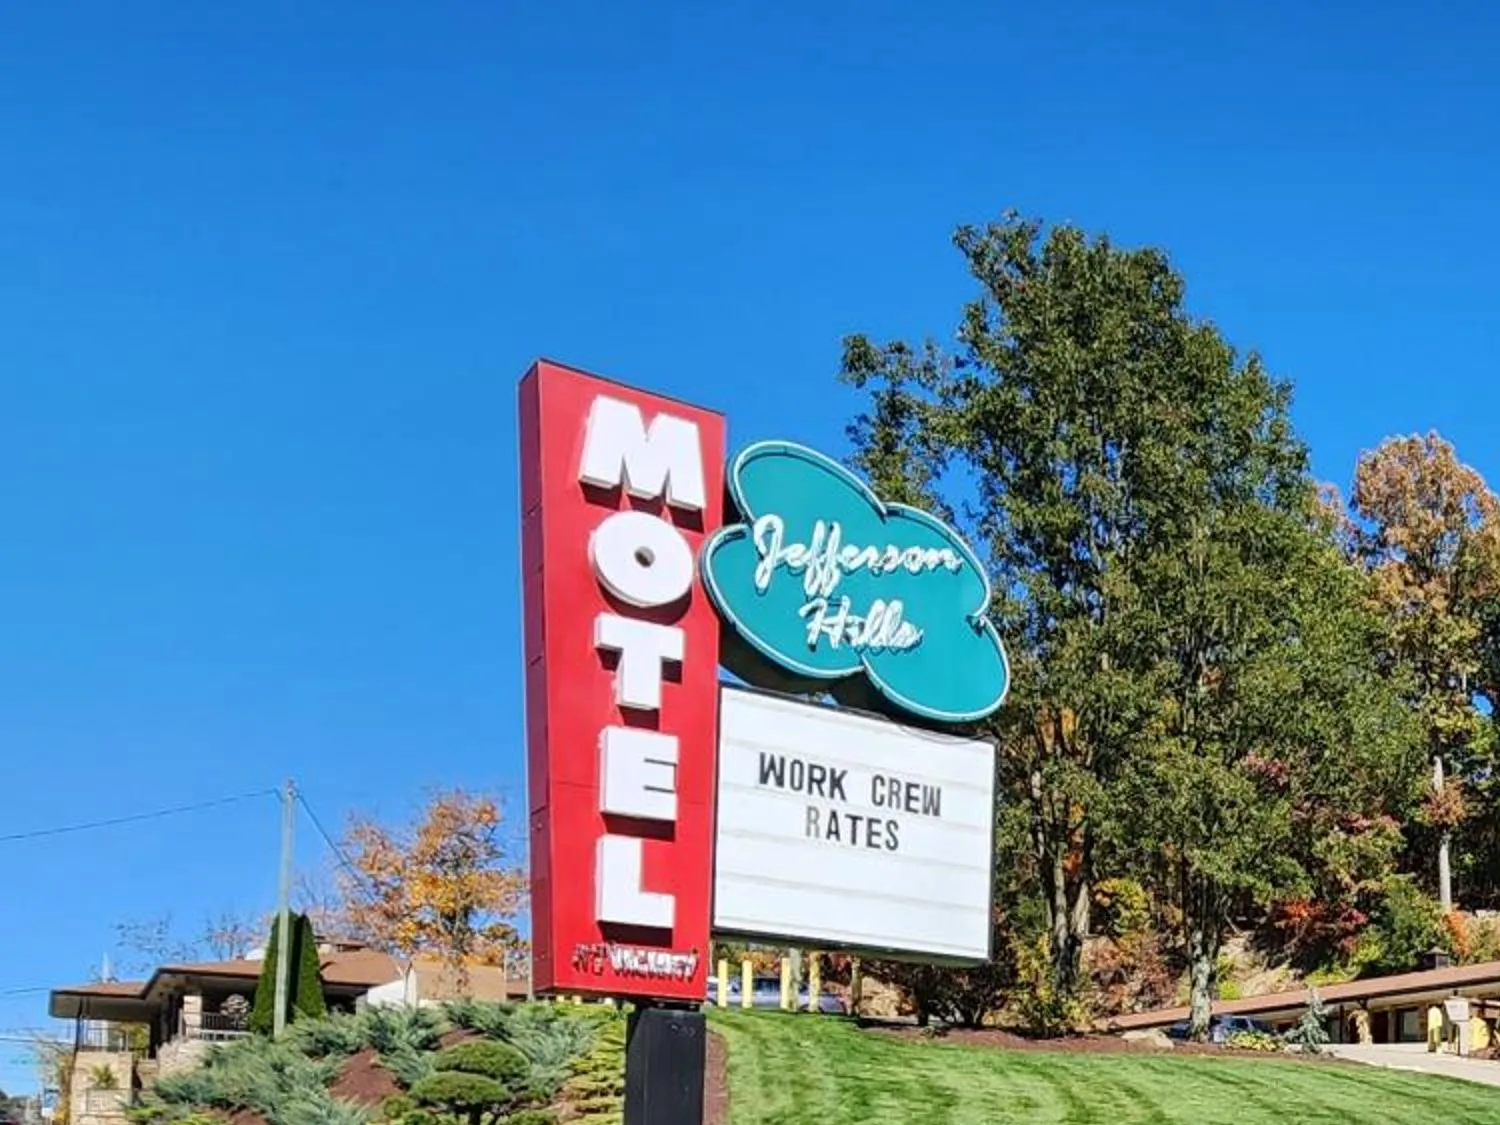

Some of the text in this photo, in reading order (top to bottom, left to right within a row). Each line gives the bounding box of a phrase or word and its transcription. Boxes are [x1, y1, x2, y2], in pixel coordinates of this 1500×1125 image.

[753, 513, 964, 597] Jefferson
[798, 595, 924, 650] Hills
[577, 394, 706, 930] MOTEL
[758, 751, 942, 818] WORK CREW
[805, 805, 899, 851] RATES
